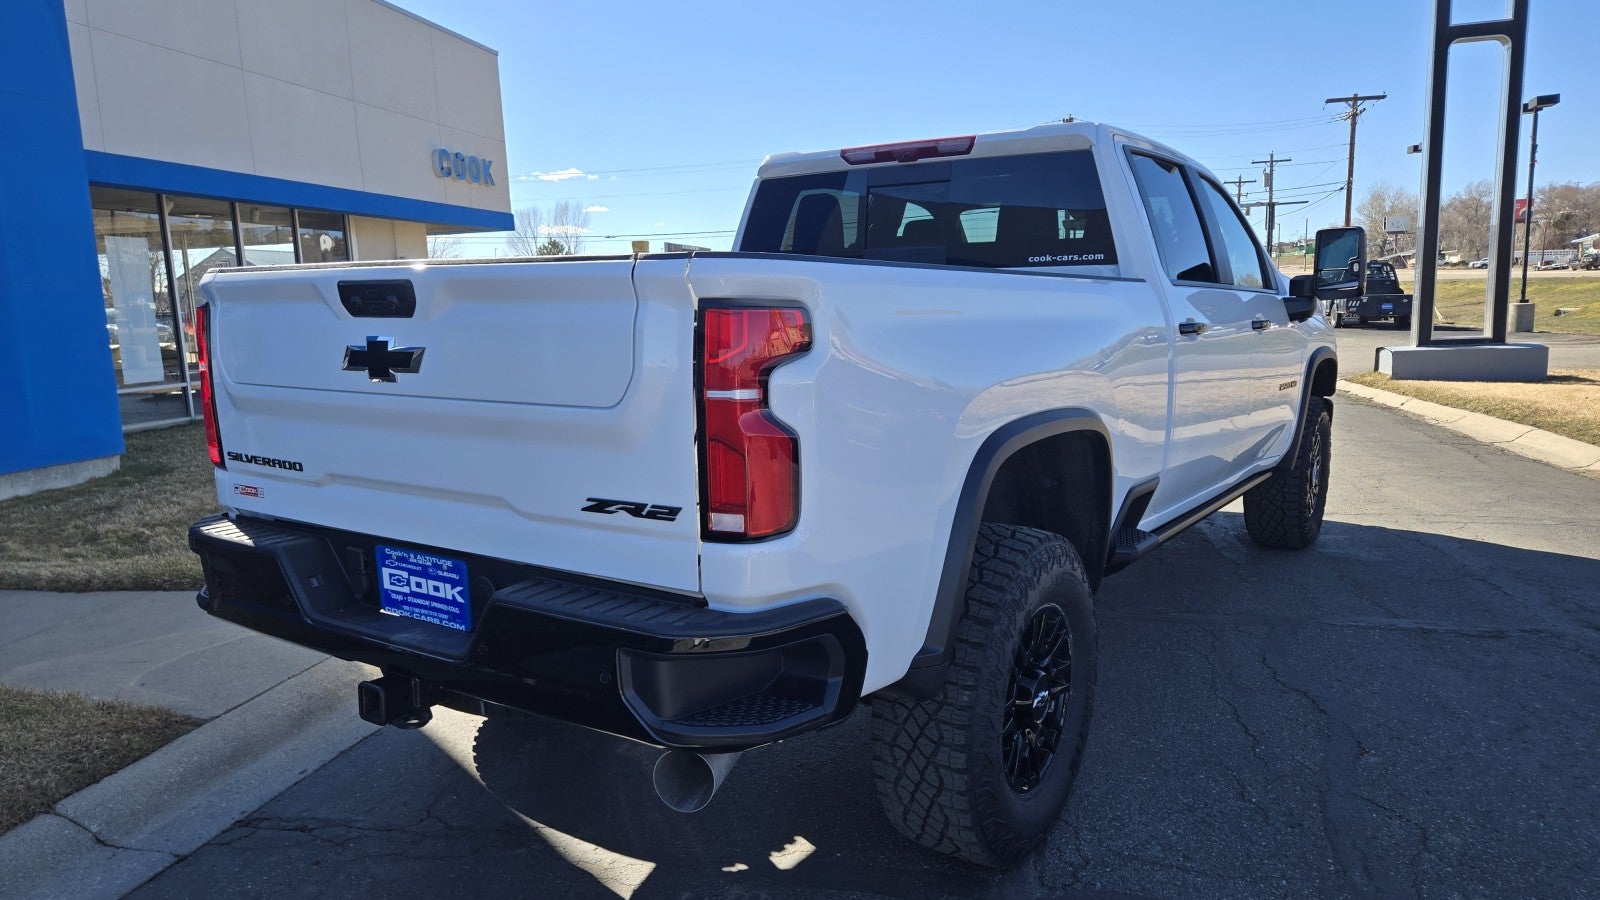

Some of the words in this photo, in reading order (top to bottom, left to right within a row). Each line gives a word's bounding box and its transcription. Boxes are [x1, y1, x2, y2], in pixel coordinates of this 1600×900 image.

[432, 148, 495, 186] COOK
[1028, 253, 1104, 262] cook-cars.com
[227, 451, 303, 472] SILVERADO
[581, 498, 682, 522] ZR2
[417, 555, 453, 566] ALTITUDE
[382, 567, 465, 603] COOK
[385, 606, 466, 631] COOK-CARS.COM
